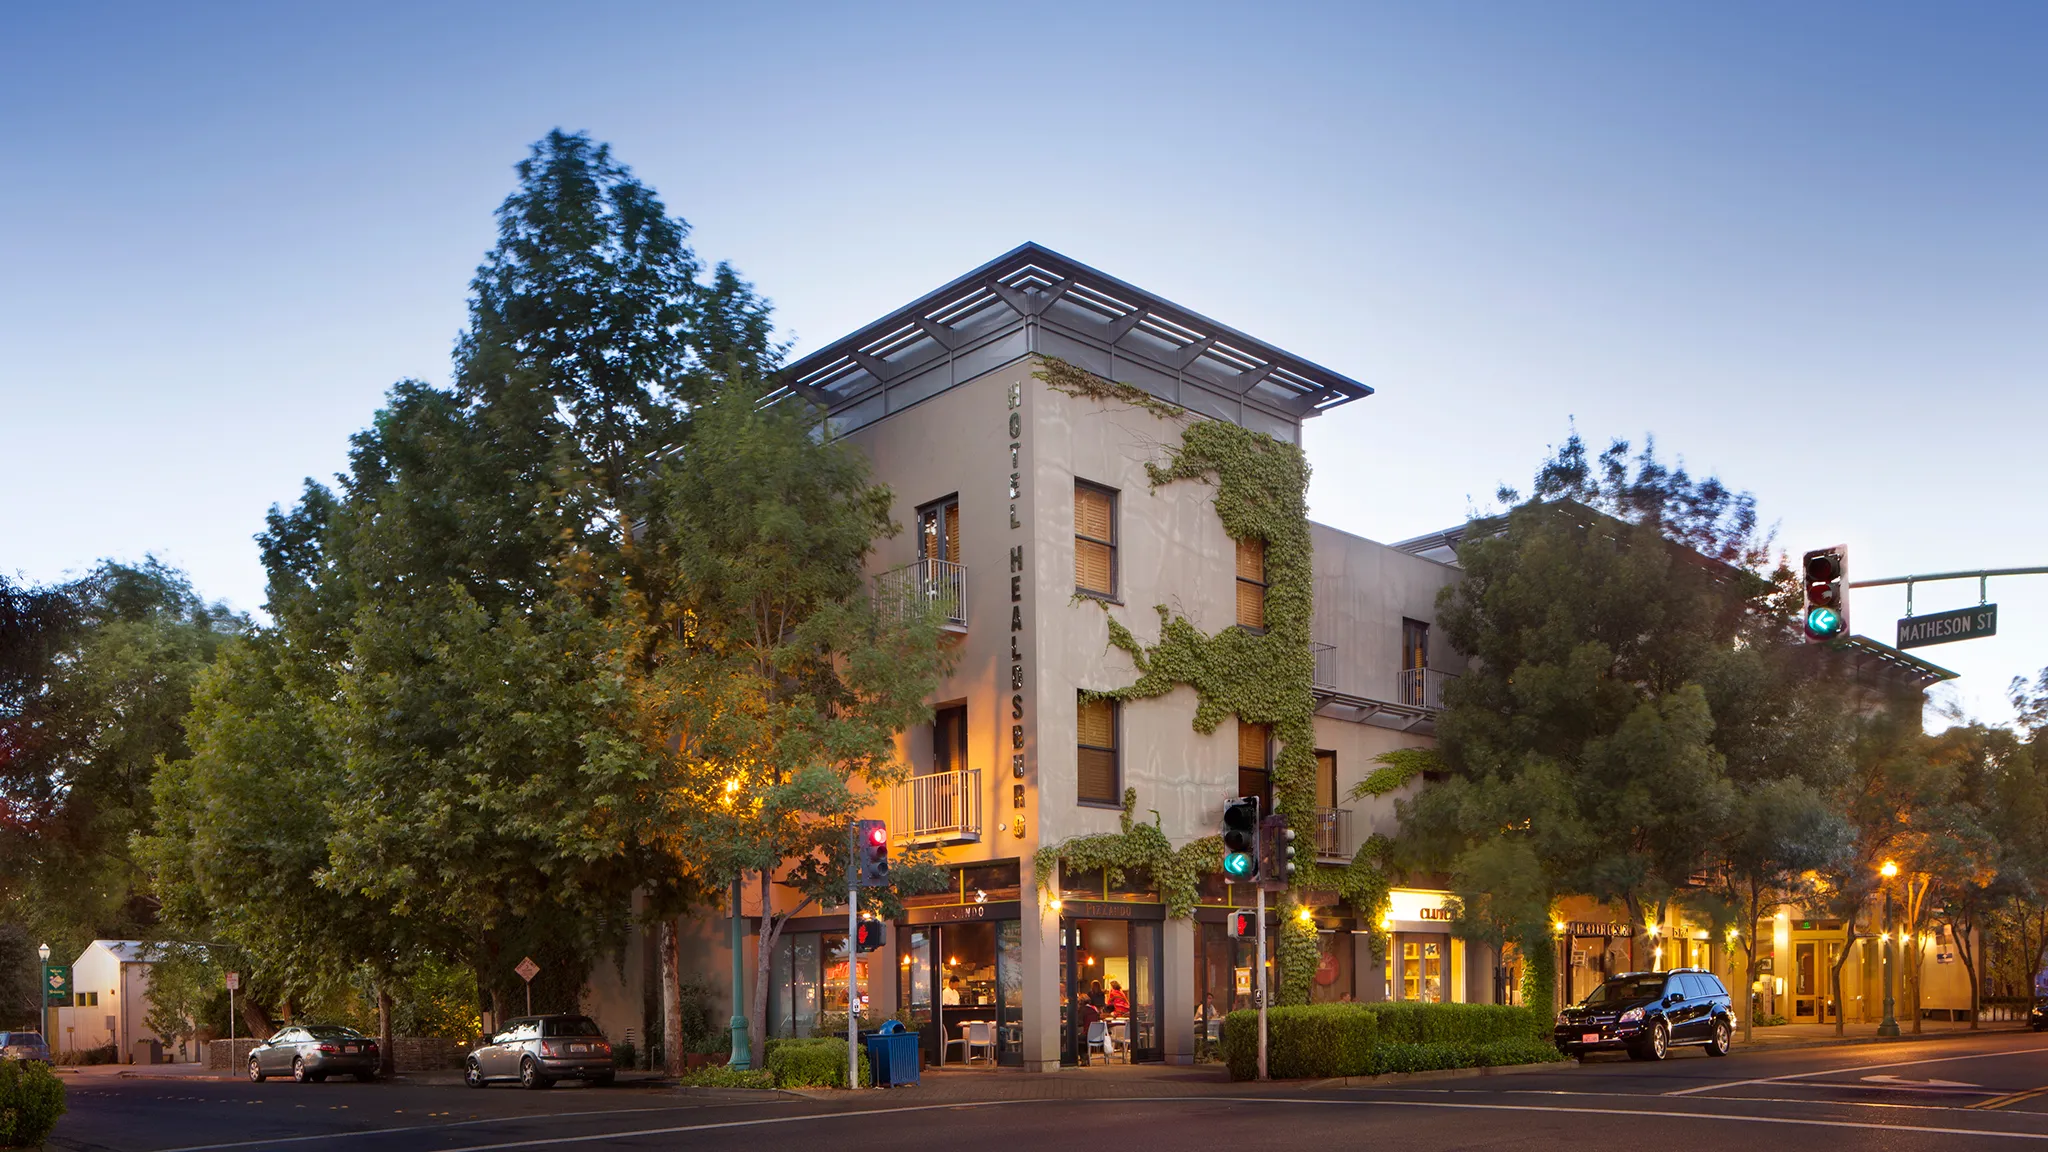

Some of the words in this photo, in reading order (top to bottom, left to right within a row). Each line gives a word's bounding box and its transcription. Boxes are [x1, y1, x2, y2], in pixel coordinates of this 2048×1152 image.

[1008, 381, 1021, 529] HOTEL
[1009, 545, 1026, 839] HEALDSBURG
[1900, 616, 1971, 642] MATHESON
[1977, 612, 1993, 630] ST
